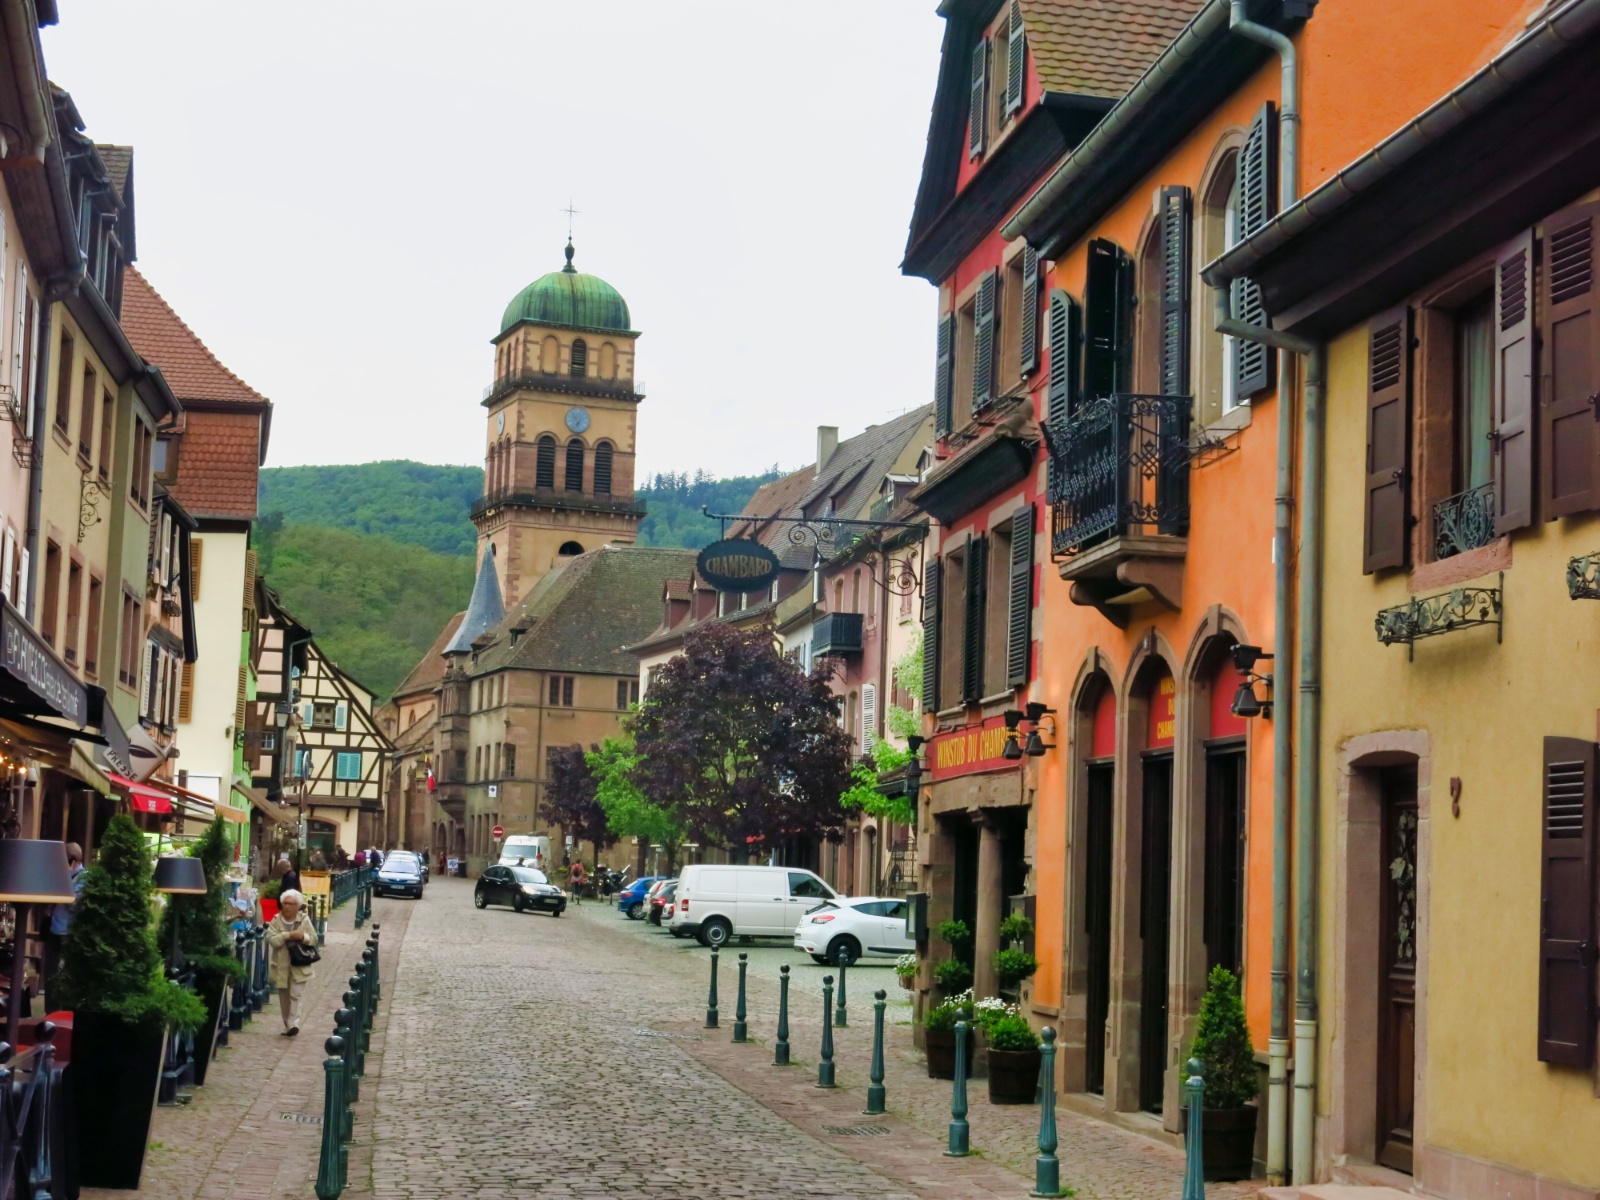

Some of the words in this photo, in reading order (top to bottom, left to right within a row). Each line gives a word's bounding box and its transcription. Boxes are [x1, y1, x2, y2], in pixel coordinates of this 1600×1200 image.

[705, 554, 773, 578] CHAMBARD
[1161, 677, 1175, 694] WINS
[1157, 721, 1175, 739] CHAMB
[937, 736, 966, 769] WINSTUB
[968, 733, 978, 763] DU
[980, 726, 1020, 761] CHAMB
[107, 750, 137, 781] PRESSE
